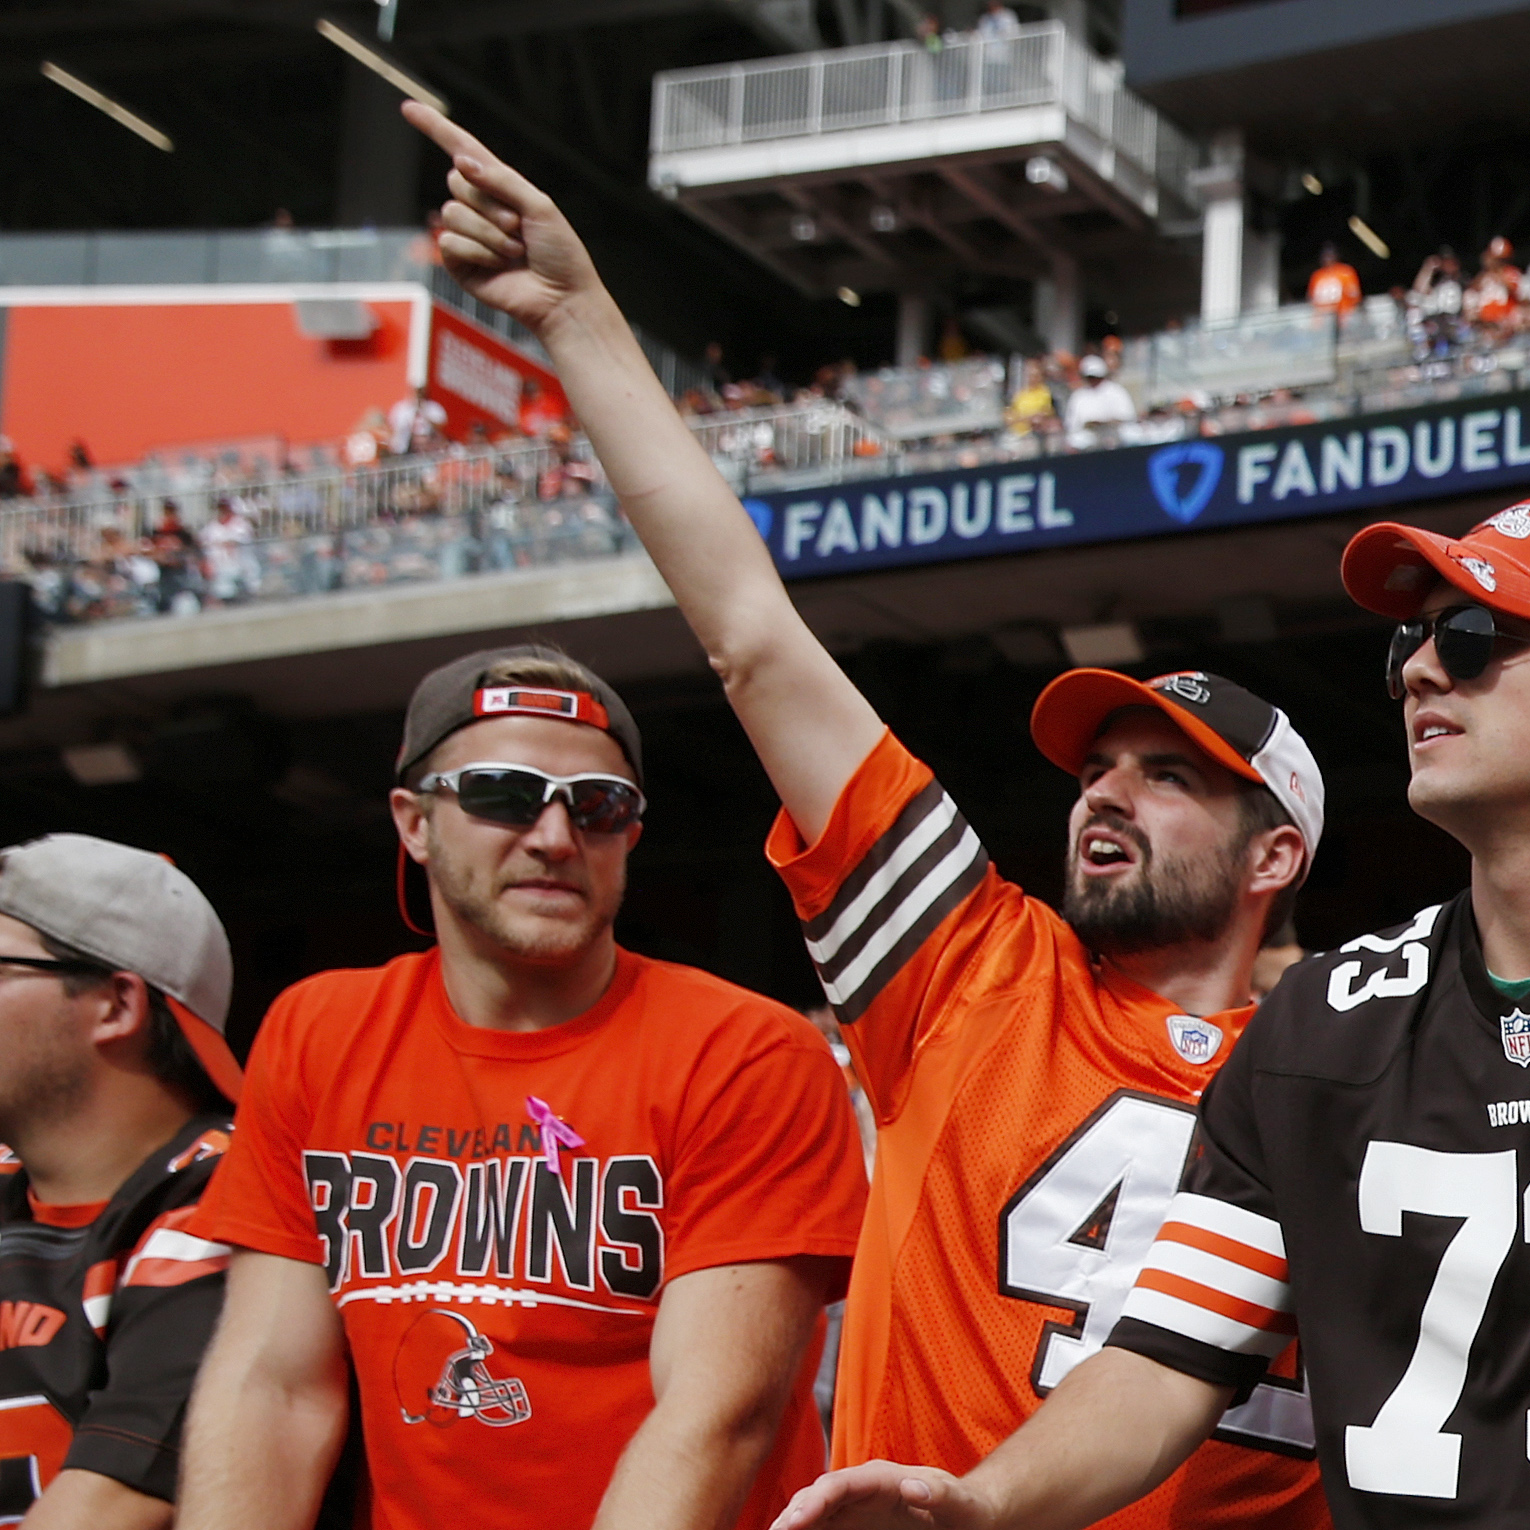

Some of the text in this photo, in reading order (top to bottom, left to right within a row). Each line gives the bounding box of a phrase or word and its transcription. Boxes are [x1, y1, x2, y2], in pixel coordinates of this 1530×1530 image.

[782, 471, 1075, 561] FANDUEL
[1326, 904, 1443, 1013] 73
[302, 1150, 665, 1298] BROWNS
